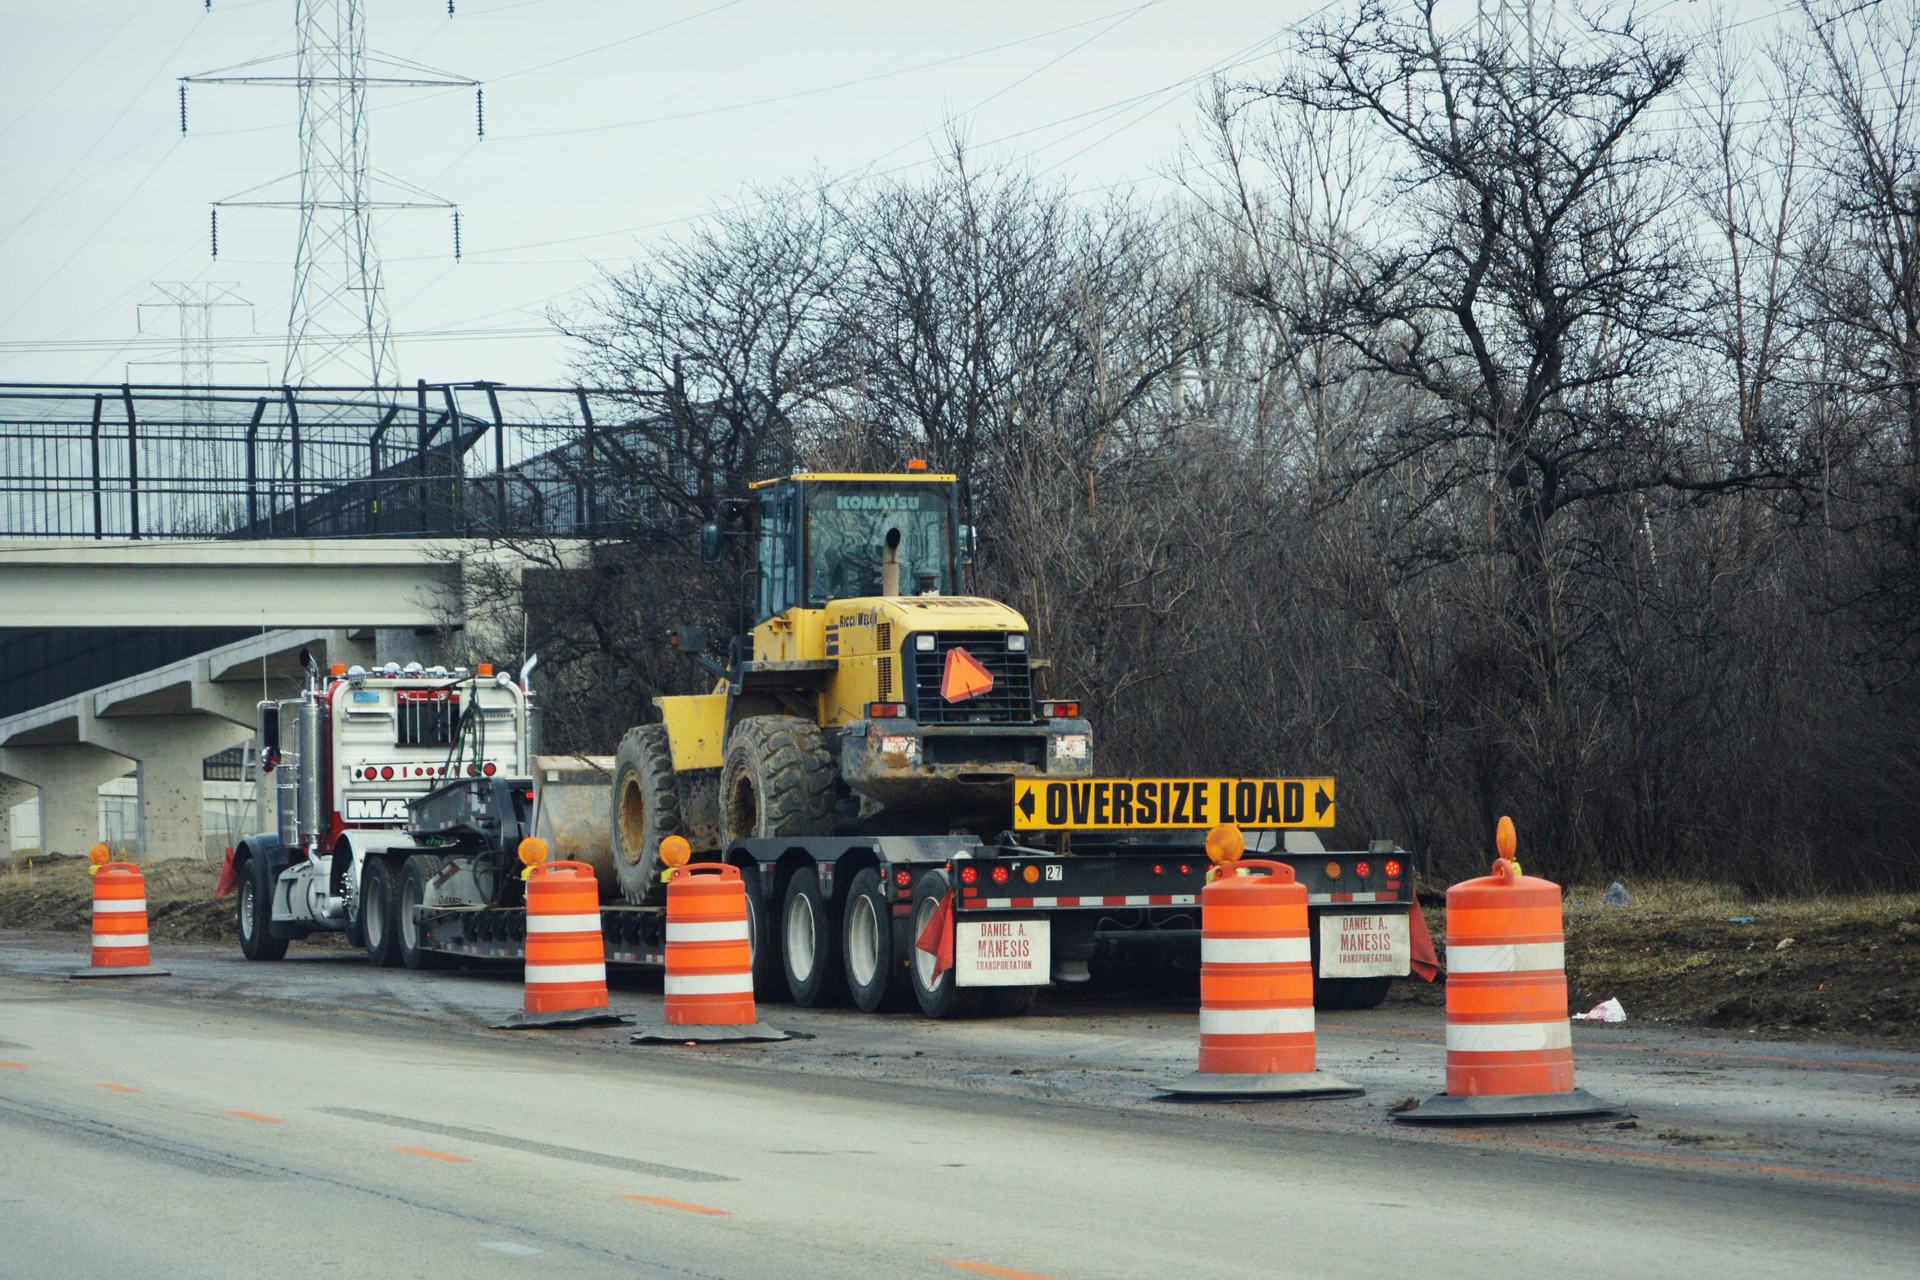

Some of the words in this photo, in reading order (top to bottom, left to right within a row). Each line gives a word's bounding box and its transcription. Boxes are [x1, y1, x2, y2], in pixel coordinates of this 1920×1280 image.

[837, 493, 919, 510] KOMATSU
[1046, 782, 1208, 825] OVERSIZE
[1219, 782, 1305, 824] LOAD
[1047, 866, 1061, 880] 27
[981, 923, 1012, 937] DANIEL
[1018, 923, 1027, 937] A.
[1343, 917, 1373, 931] DANIEL
[1378, 917, 1388, 930] A.
[978, 939, 1030, 958] MANESIS
[1340, 933, 1391, 951] MANESIS
[976, 960, 1032, 971] TRANSPORTATION
[1339, 953, 1393, 964] TRANSPORTATION
